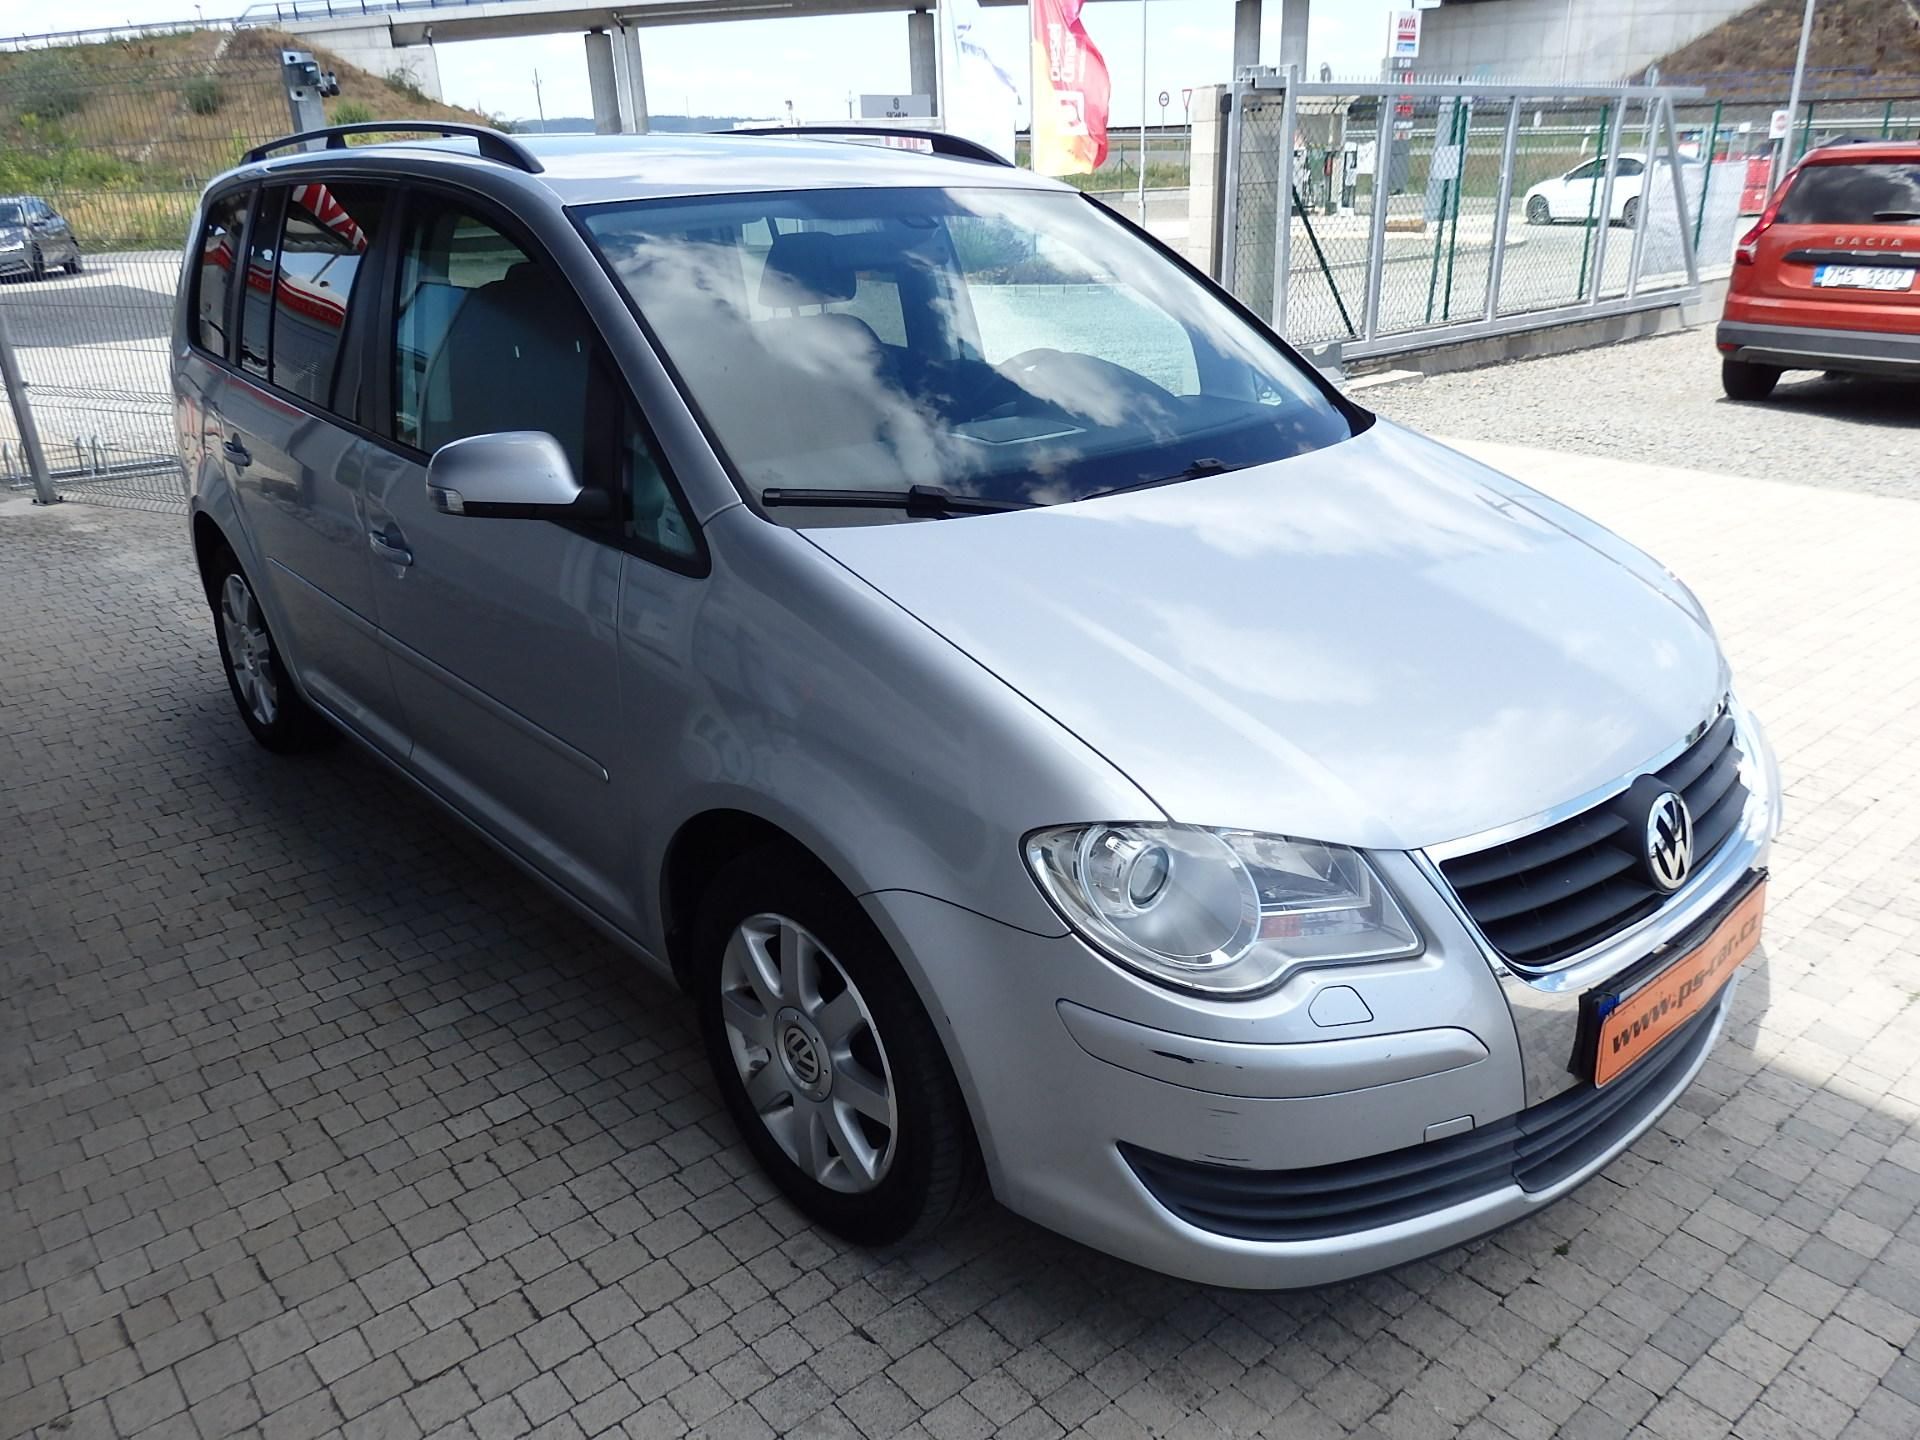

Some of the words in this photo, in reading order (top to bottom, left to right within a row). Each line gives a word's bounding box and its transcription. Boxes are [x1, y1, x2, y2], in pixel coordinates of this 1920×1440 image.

[1398, 16, 1416, 29] AVIA
[1834, 237, 1903, 247] DACIA
[1612, 913, 1758, 1054] www.ps-car.cz
